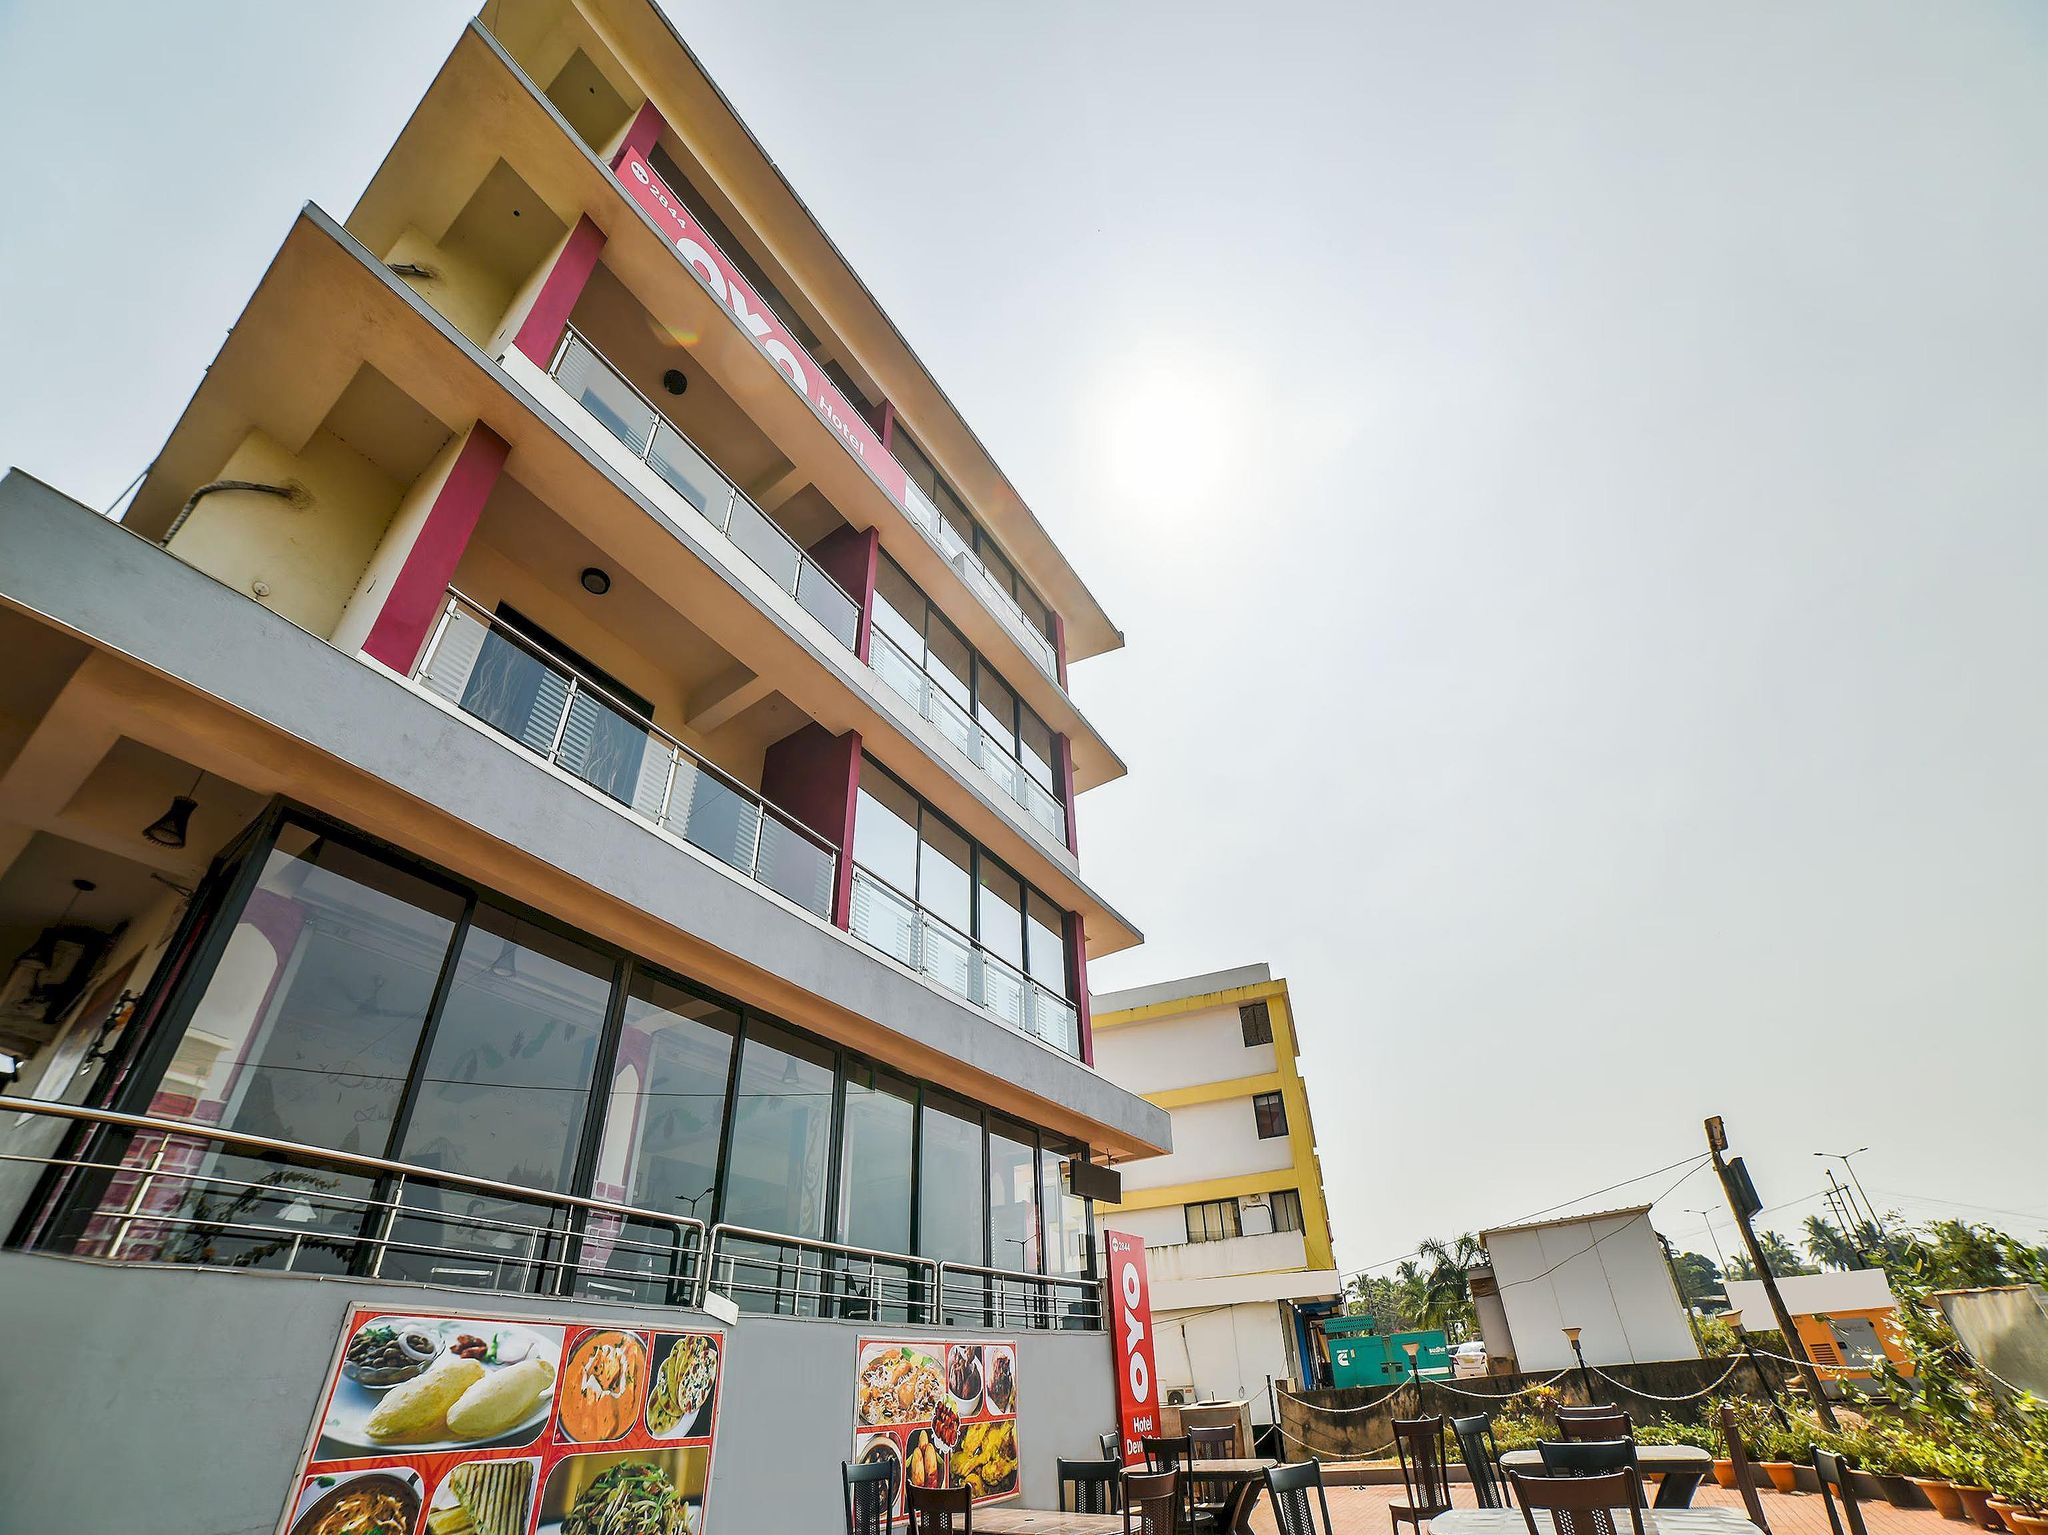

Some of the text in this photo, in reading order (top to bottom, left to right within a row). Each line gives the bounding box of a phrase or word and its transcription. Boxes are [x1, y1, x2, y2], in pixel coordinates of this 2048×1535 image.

[650, 184, 686, 229] 2844
[676, 237, 808, 397] OYO
[820, 395, 864, 456] Hotel
[1122, 1262, 1149, 1403] OYO
[1133, 1415, 1153, 1433] Hotel
